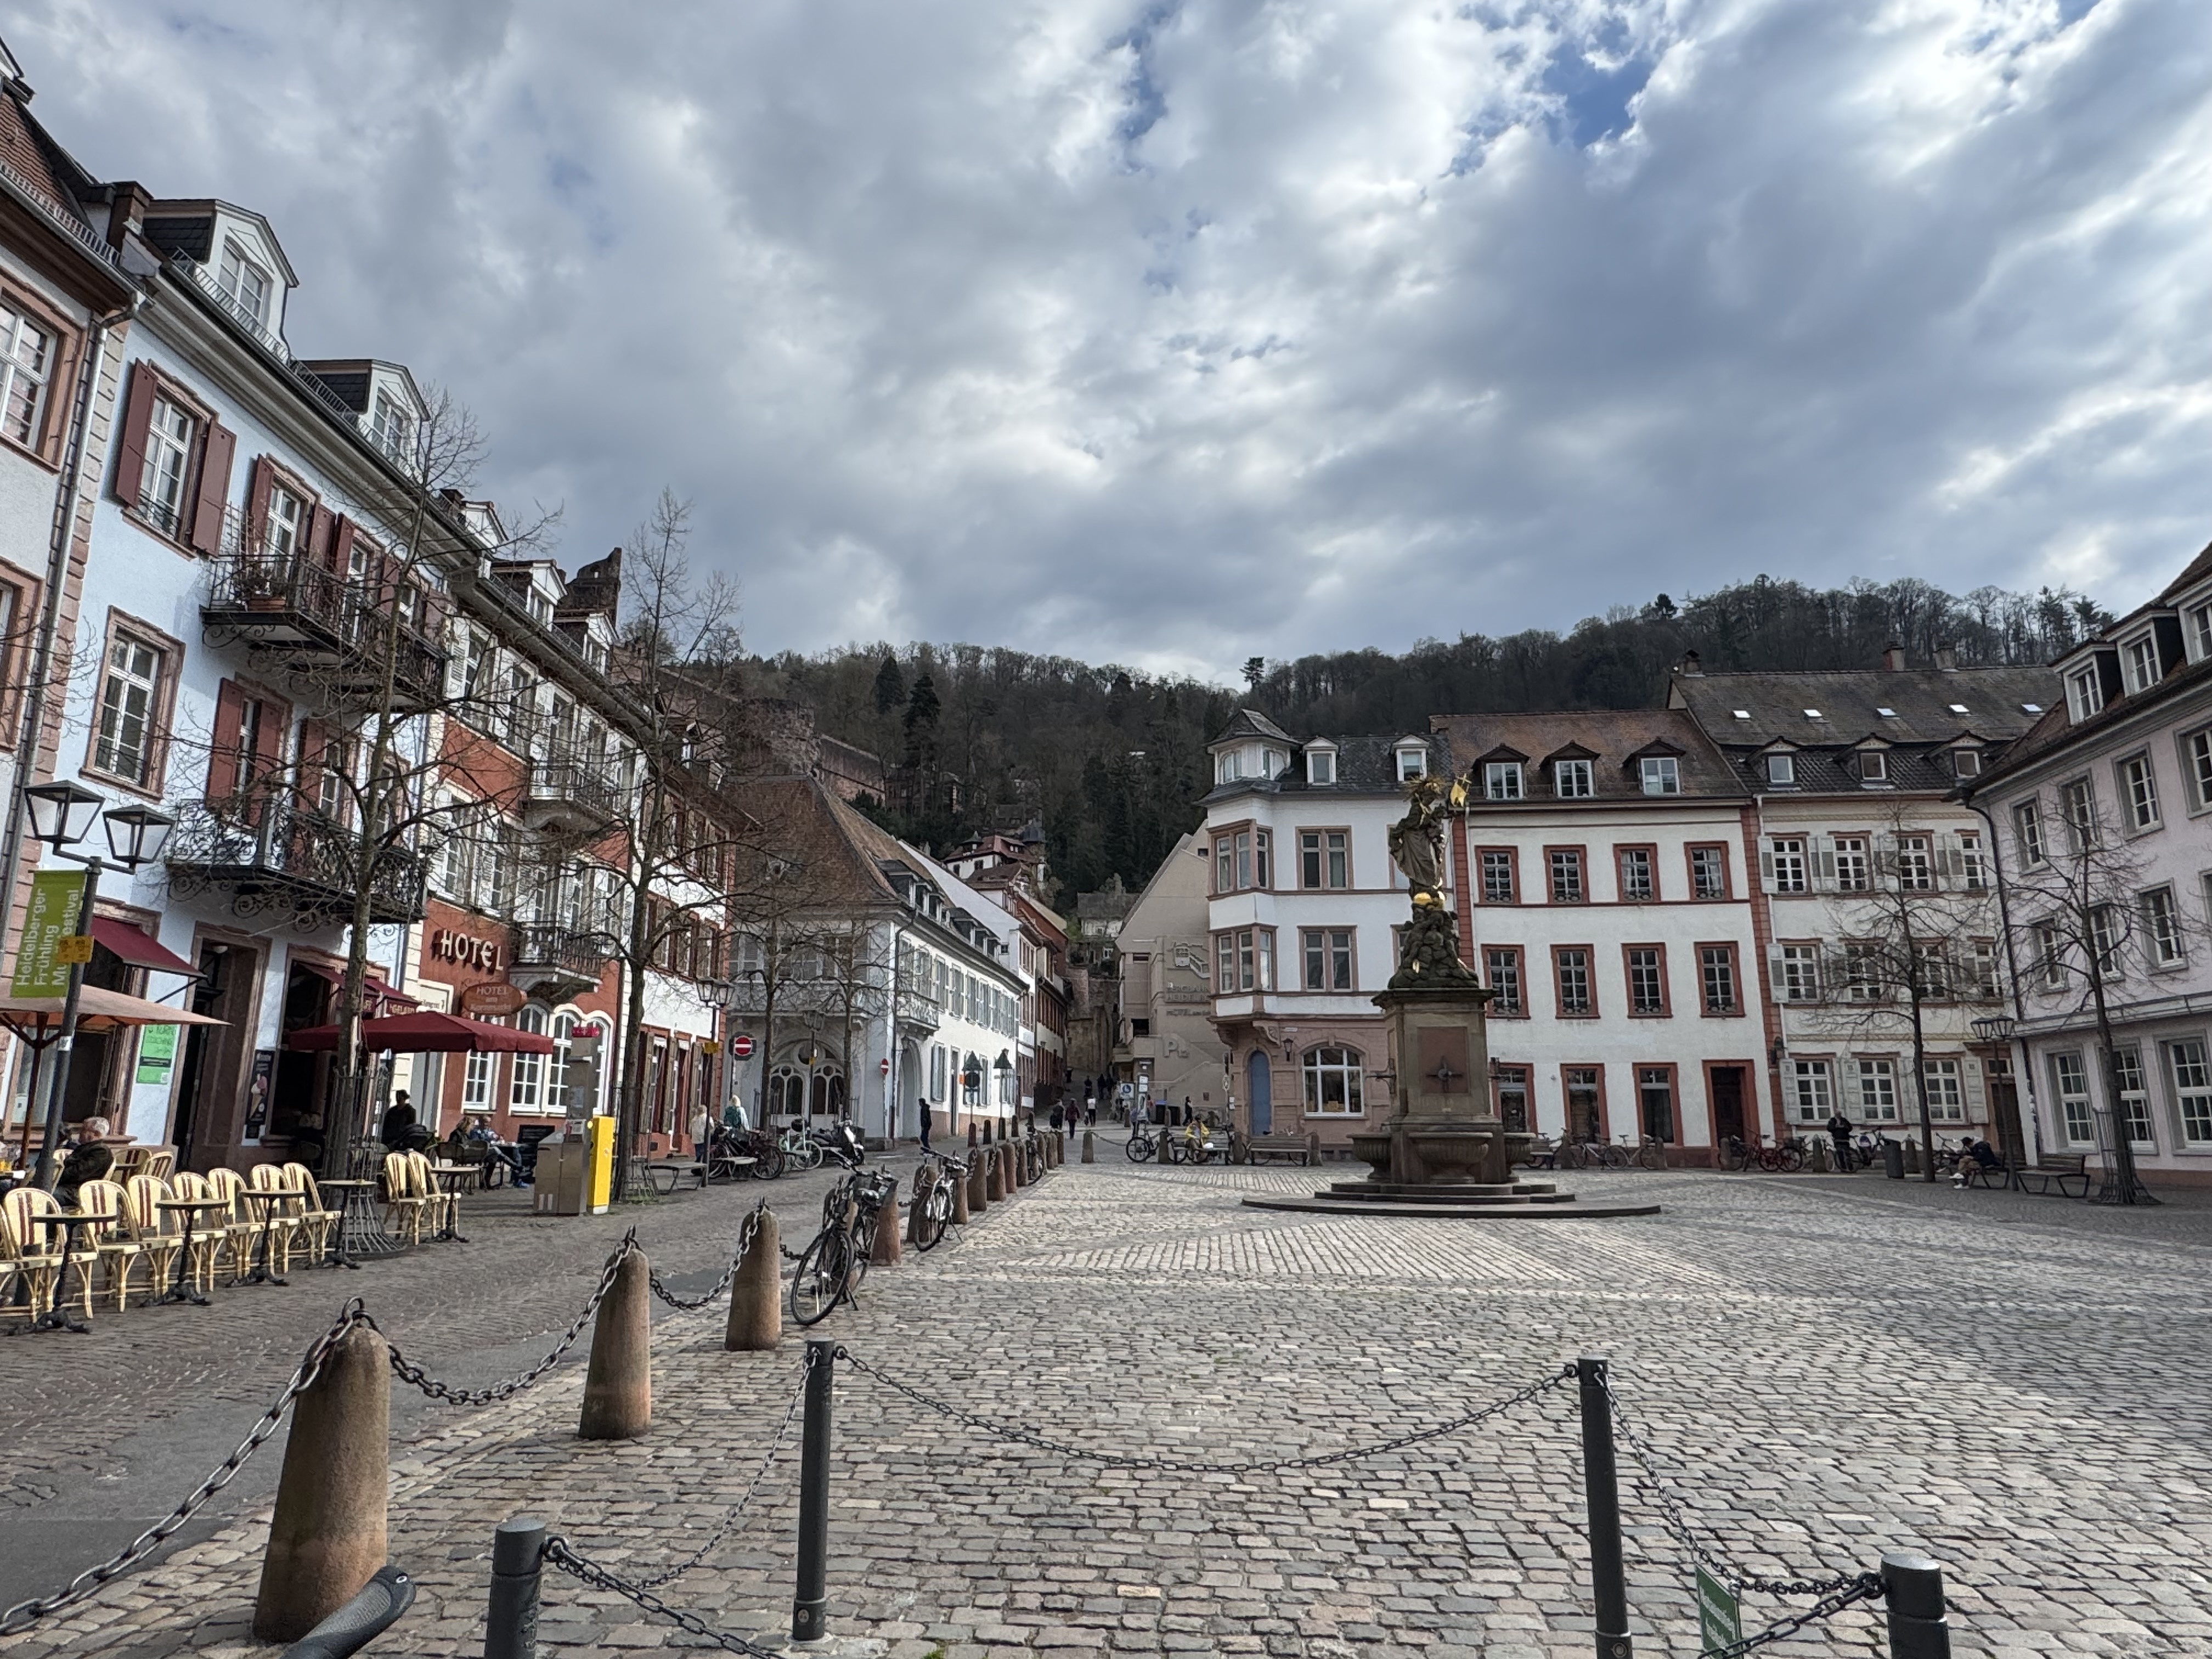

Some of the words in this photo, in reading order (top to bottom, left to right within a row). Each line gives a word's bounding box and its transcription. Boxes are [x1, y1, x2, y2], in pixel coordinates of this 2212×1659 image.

[15, 888, 46, 985] Heidelberger
[33, 925, 60, 985] Frühling
[440, 929, 504, 971] HOTEL
[476, 986, 508, 995] HOTEL
